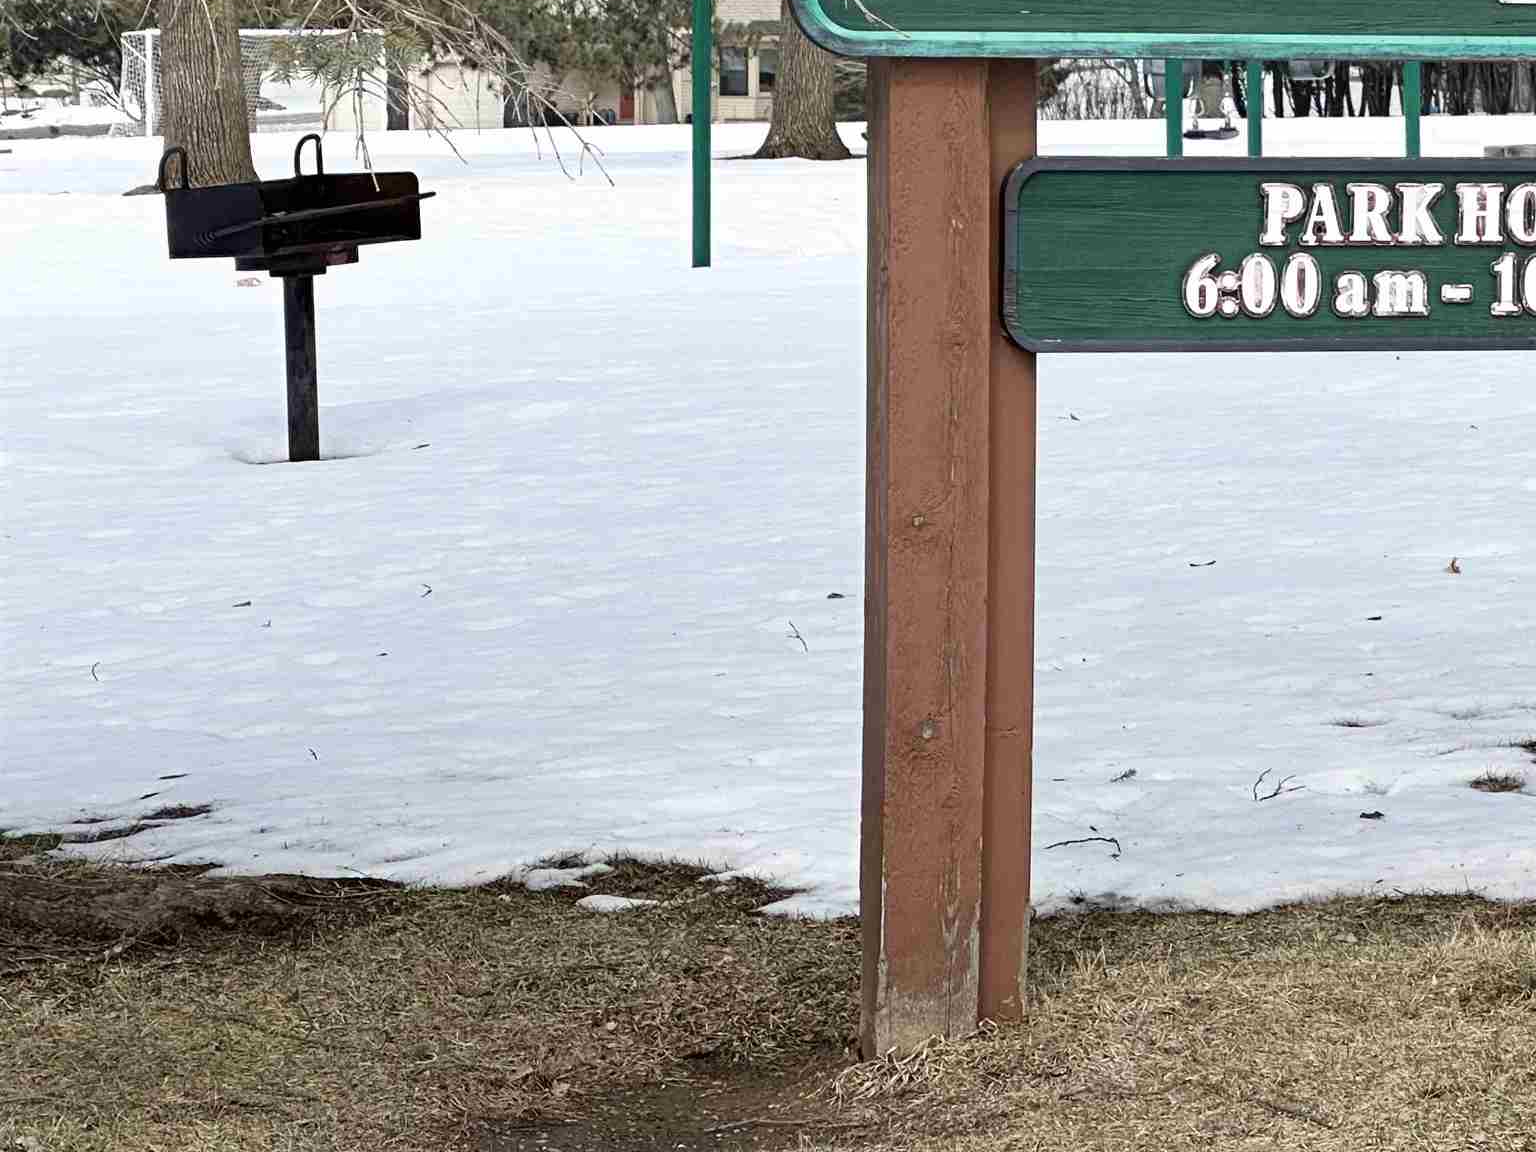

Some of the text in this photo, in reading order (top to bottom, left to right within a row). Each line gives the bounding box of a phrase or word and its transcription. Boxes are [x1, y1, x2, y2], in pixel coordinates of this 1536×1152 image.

[1259, 181, 1444, 247] PARK
[1182, 251, 1321, 318] 6:00
[1334, 269, 1430, 318] am
